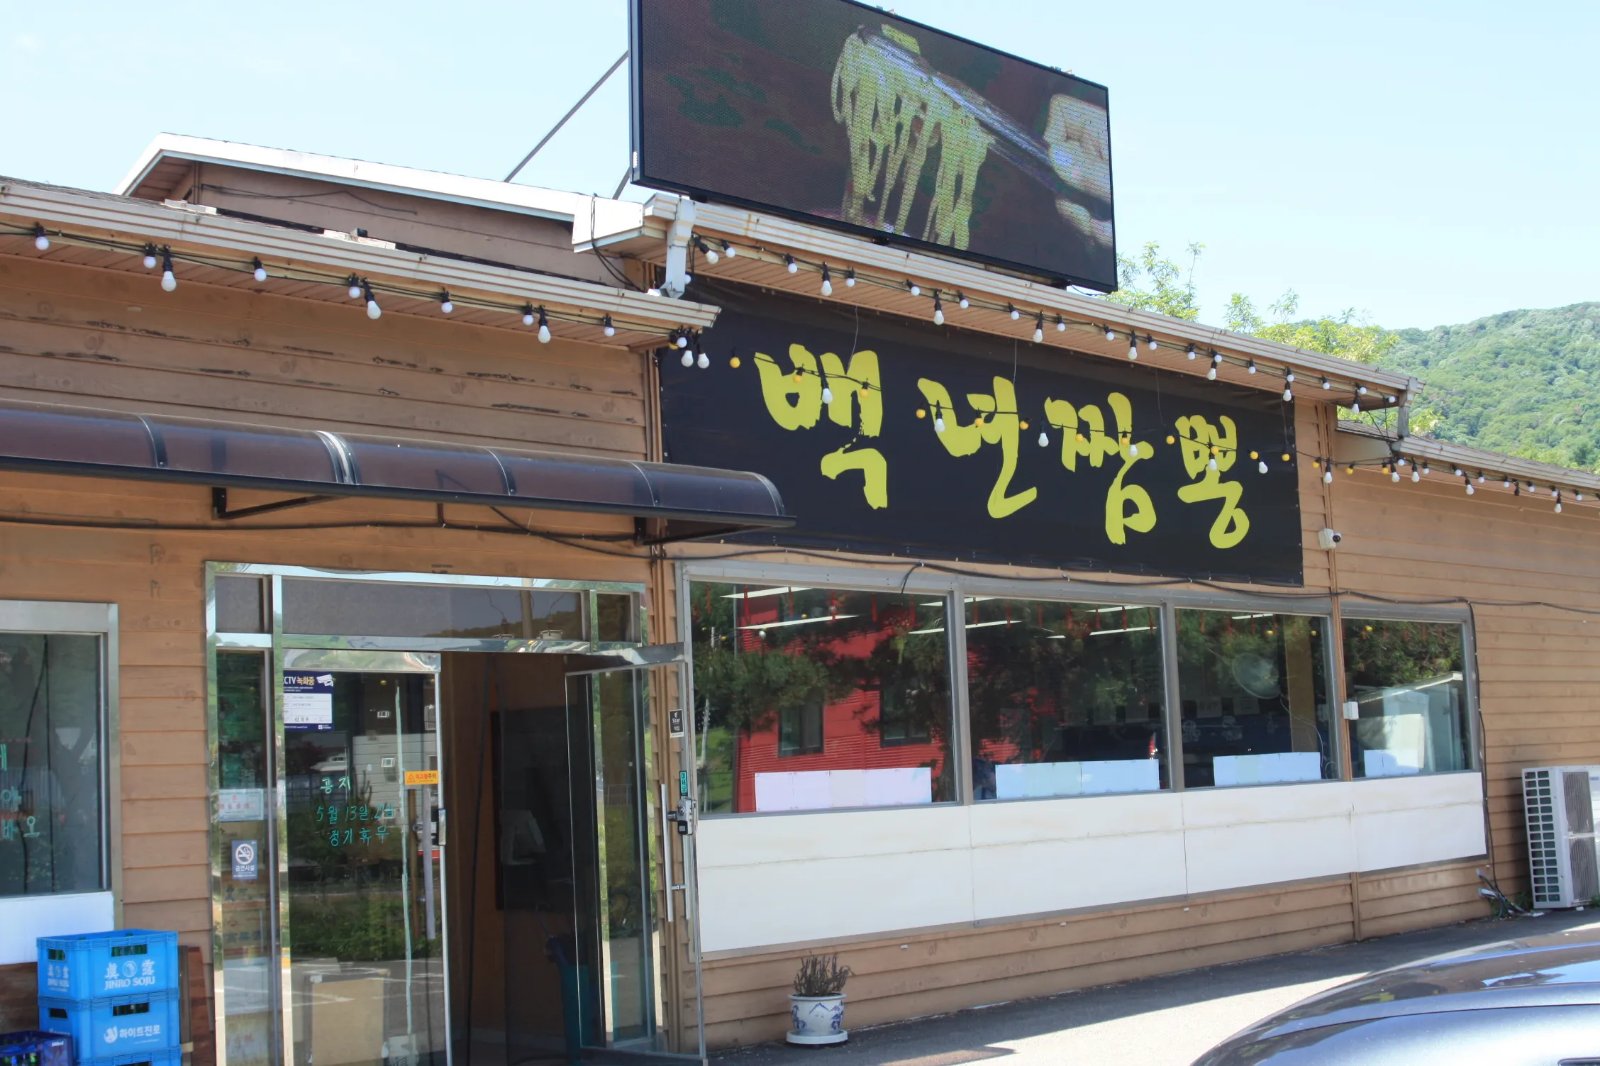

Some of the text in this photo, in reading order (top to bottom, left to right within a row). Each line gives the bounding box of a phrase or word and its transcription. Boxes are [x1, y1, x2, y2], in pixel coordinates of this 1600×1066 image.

[754, 343, 1250, 549] 백년짬뽕
[320, 776, 351, 794] 공지
[316, 805, 338, 825] 5월
[329, 825, 390, 847] 정기 휴무
[132, 976, 155, 987] SOJU
[119, 1025, 161, 1038] 하이트진로
